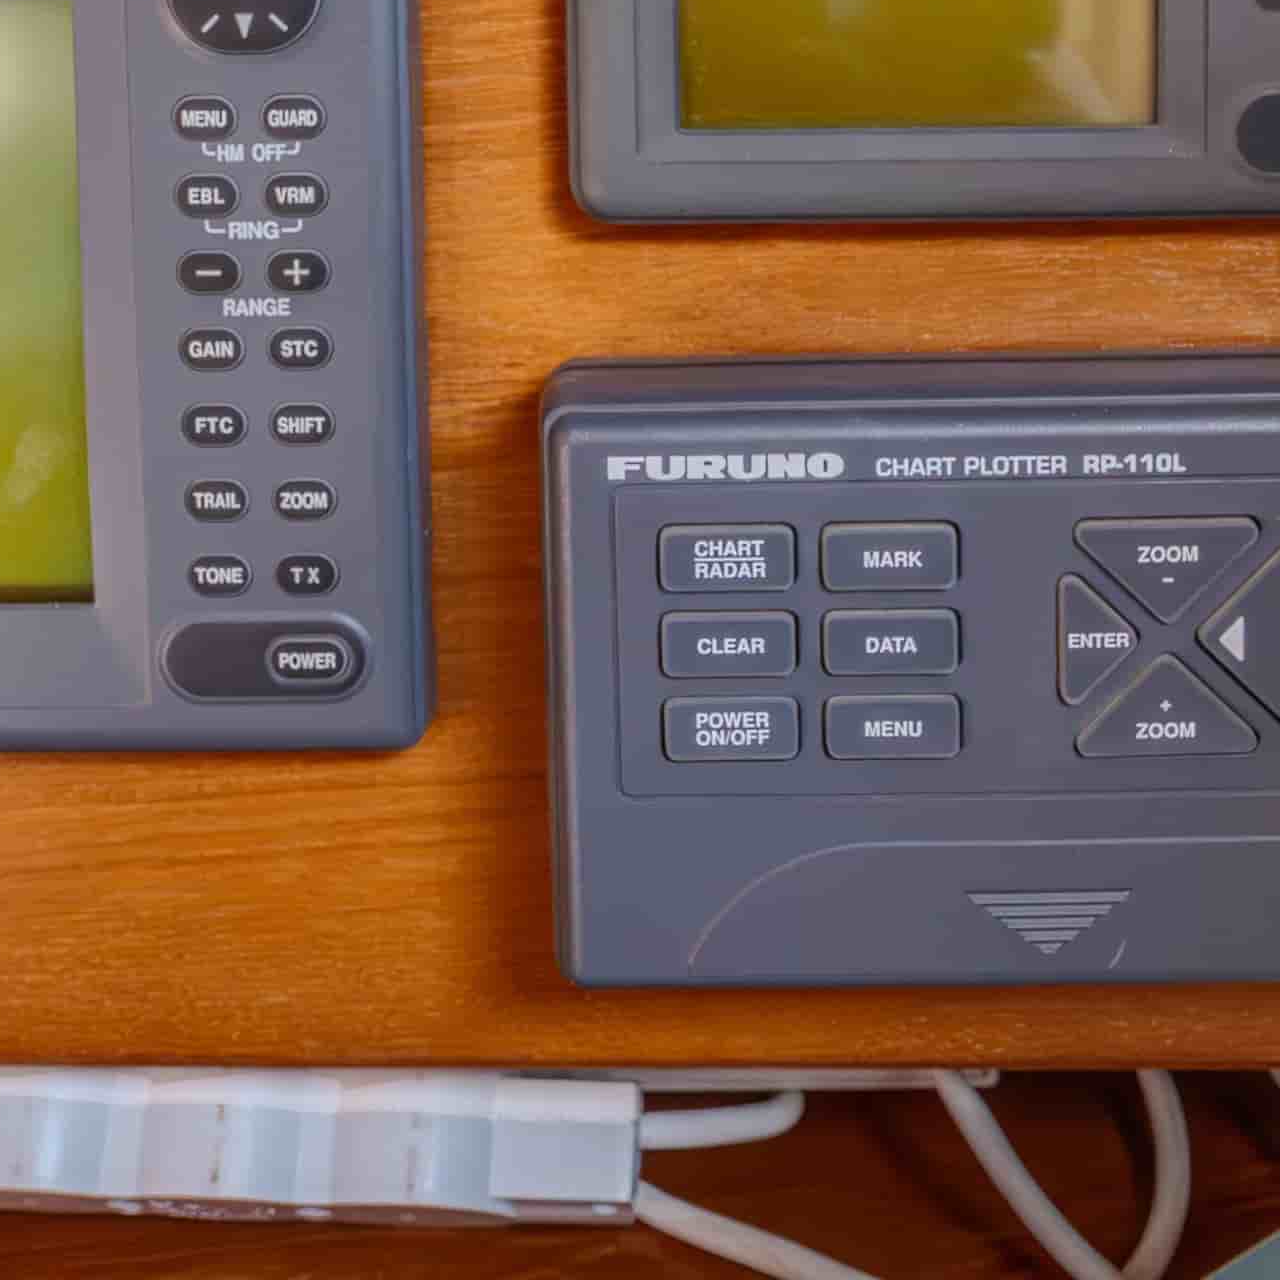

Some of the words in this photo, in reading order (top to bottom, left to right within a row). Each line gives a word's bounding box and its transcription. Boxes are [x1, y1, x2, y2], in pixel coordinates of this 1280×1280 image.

[180, 108, 228, 128] MENU
[267, 108, 319, 128] GUARD
[216, 143, 245, 162] HM
[251, 142, 288, 162] OFF
[187, 186, 226, 206] EBL
[274, 186, 316, 205] VRM
[227, 220, 281, 241] RING
[222, 297, 292, 317] RANGE
[188, 340, 234, 358] GAIN
[280, 339, 319, 358] STC
[194, 416, 234, 435] FTC
[277, 416, 326, 434] SHIFT
[607, 452, 845, 481] FURUNO
[875, 457, 956, 478] CHART
[964, 455, 1067, 477] PLOTTER
[1082, 452, 1188, 475] RP-110L
[192, 491, 241, 510] TRAIL
[279, 491, 329, 510] ZOOM
[694, 539, 765, 558] CHART
[1136, 545, 1199, 564] ZOOM
[863, 550, 924, 569] MARK
[194, 567, 244, 585] TONE
[694, 561, 767, 580] RADAR
[696, 637, 766, 656] CLEAR
[865, 636, 918, 654] DATA
[1067, 632, 1131, 650] ENTER
[278, 651, 337, 670] POWER
[695, 711, 770, 730] POWER
[864, 719, 923, 738] MENU
[695, 728, 770, 747] ON/OFF
[1135, 721, 1197, 740] ZOOM
